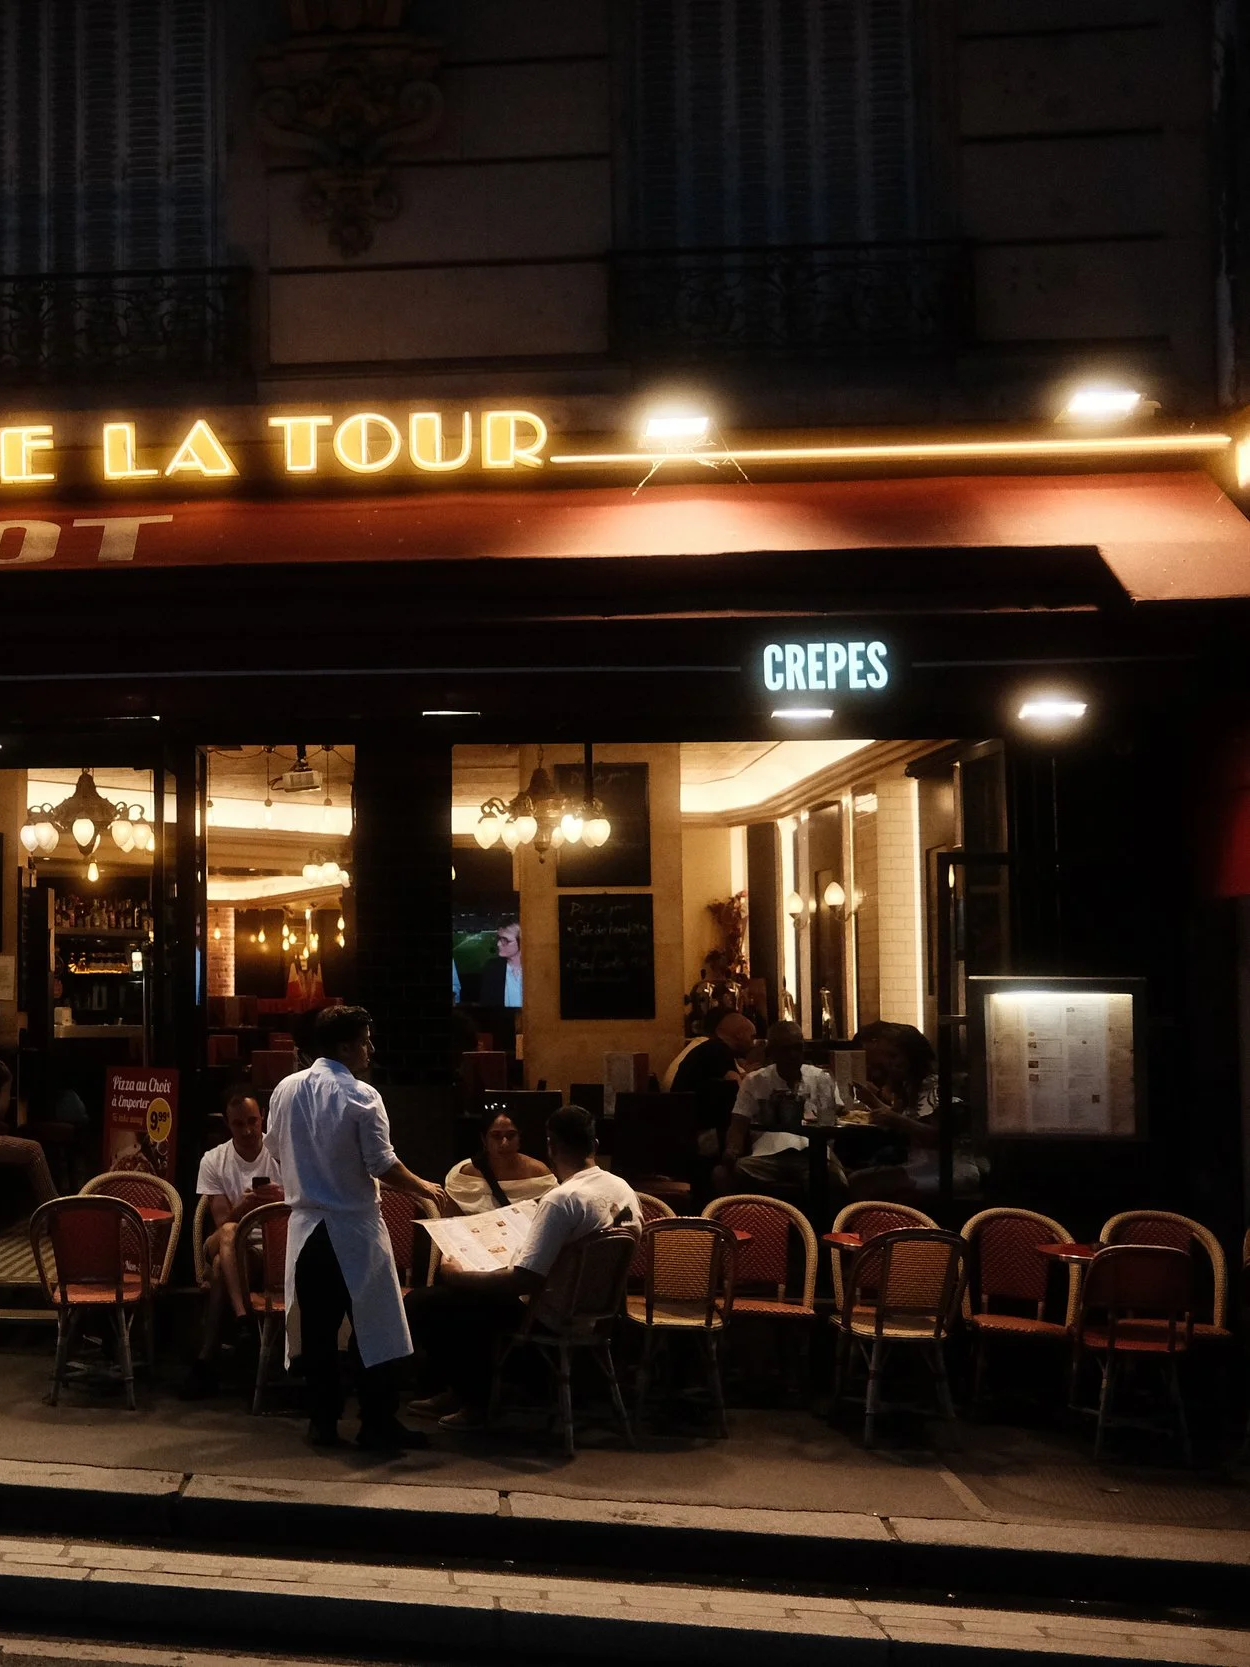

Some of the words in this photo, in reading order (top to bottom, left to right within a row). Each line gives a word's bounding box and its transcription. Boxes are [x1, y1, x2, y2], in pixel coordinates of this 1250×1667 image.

[103, 419, 240, 481] LA
[268, 410, 548, 474] TOUR
[763, 641, 889, 691] CREPES
[112, 1074, 135, 1092] Pizza
[136, 1079, 147, 1093] au
[148, 1077, 172, 1094] Choix
[111, 1094, 117, 1108] à
[118, 1094, 150, 1112] Emporter
